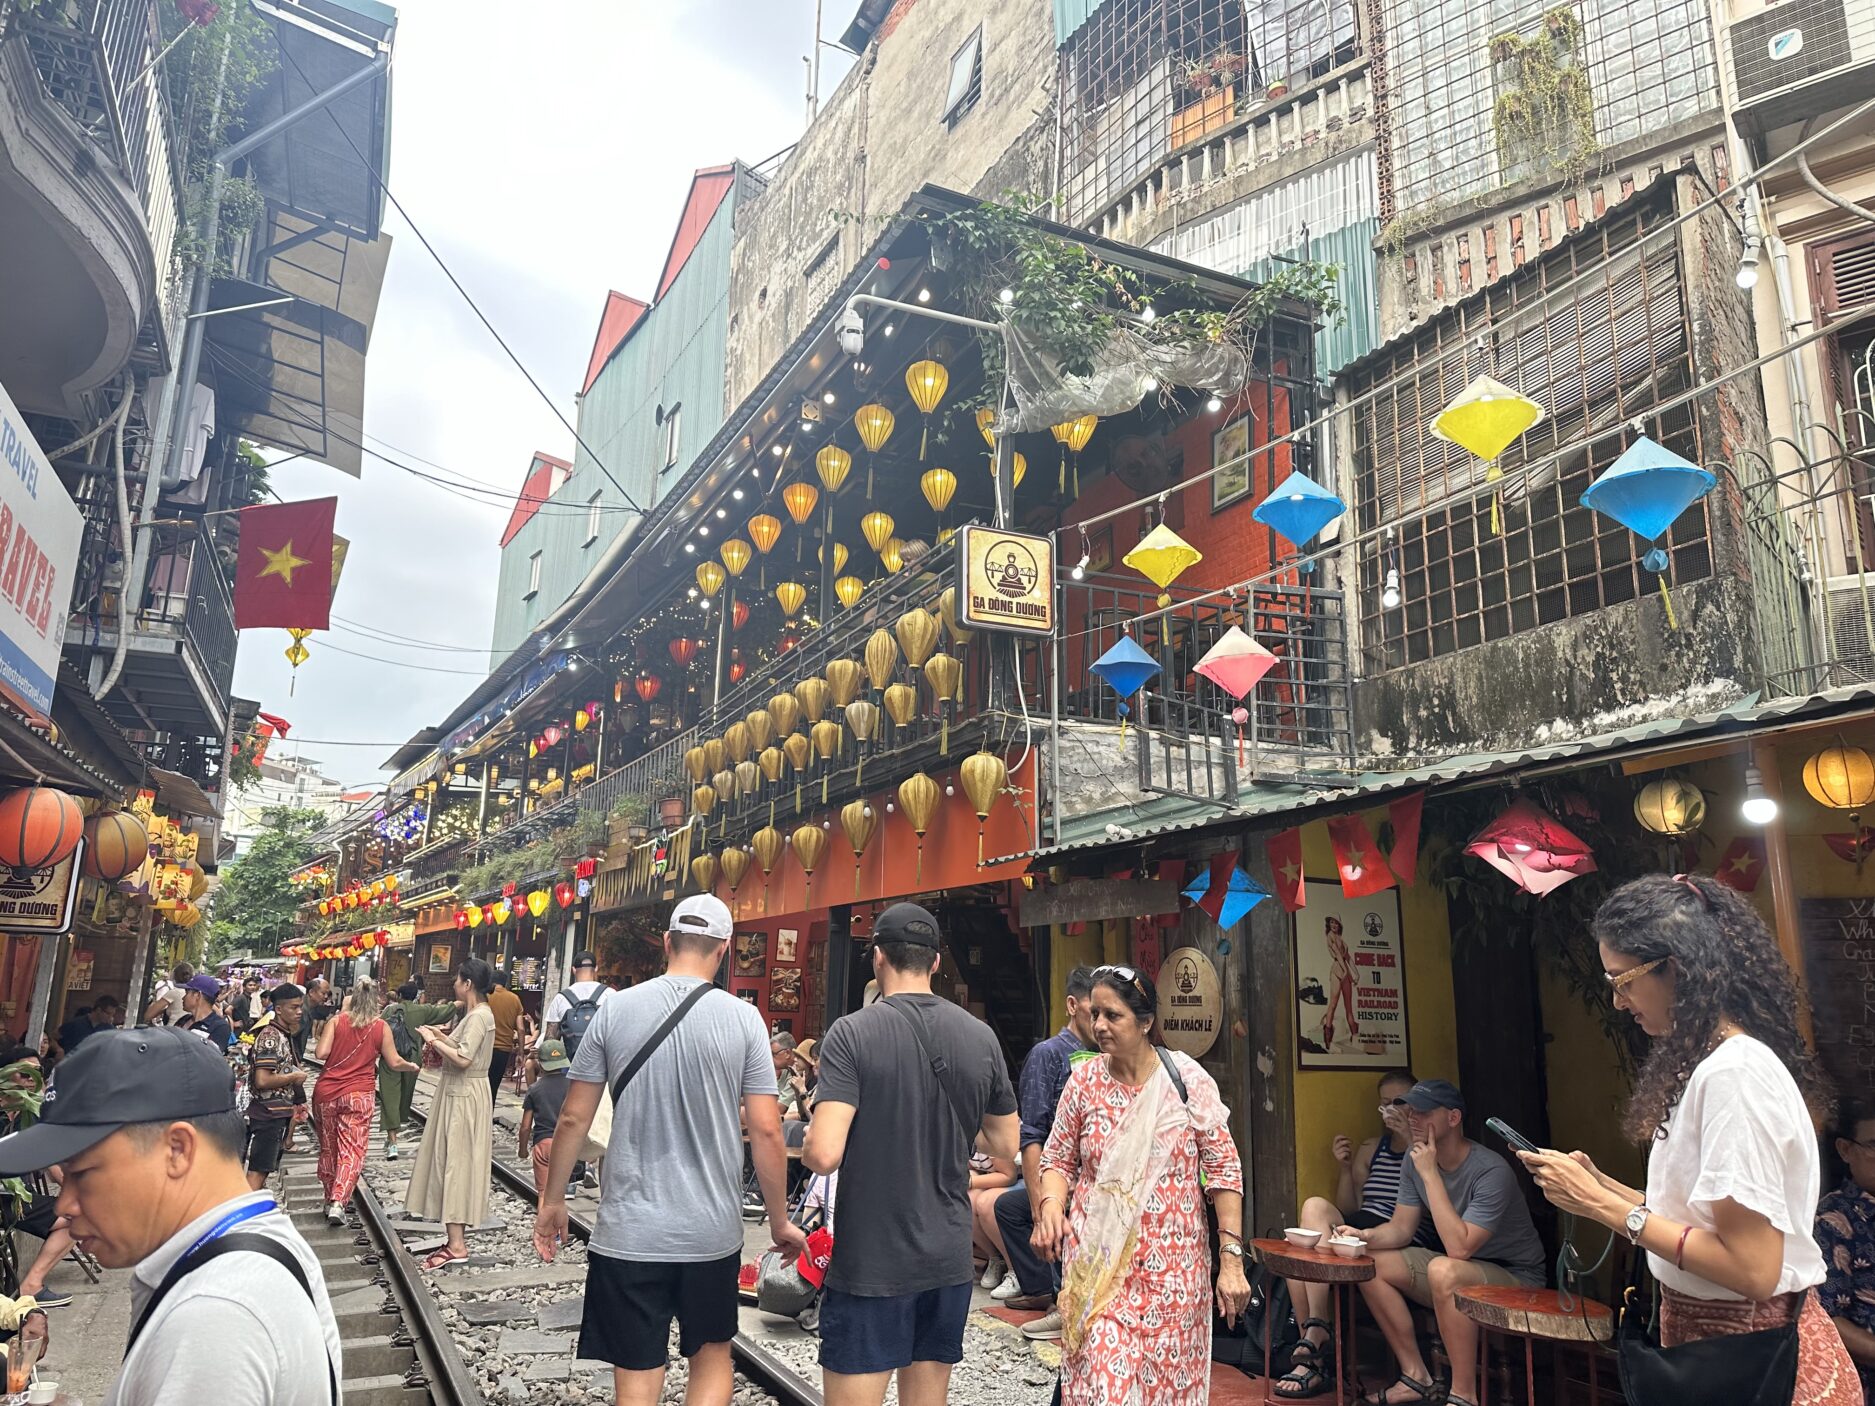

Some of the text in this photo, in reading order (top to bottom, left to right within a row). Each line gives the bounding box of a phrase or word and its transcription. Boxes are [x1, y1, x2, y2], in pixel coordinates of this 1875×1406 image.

[0, 417, 38, 500] TRAVEL
[0, 501, 55, 639] RAVEL
[973, 595, 1047, 618] GA ĐÔNG DƯƠNG
[19, 901, 58, 915] DƯƠNG
[1371, 971, 1381, 985] TO
[1357, 986, 1398, 998] VIETNAM
[1357, 999, 1399, 1009] RAILROAD
[1357, 1011, 1399, 1021] HISTORY
[1180, 1015, 1204, 1032] KHÁCH
